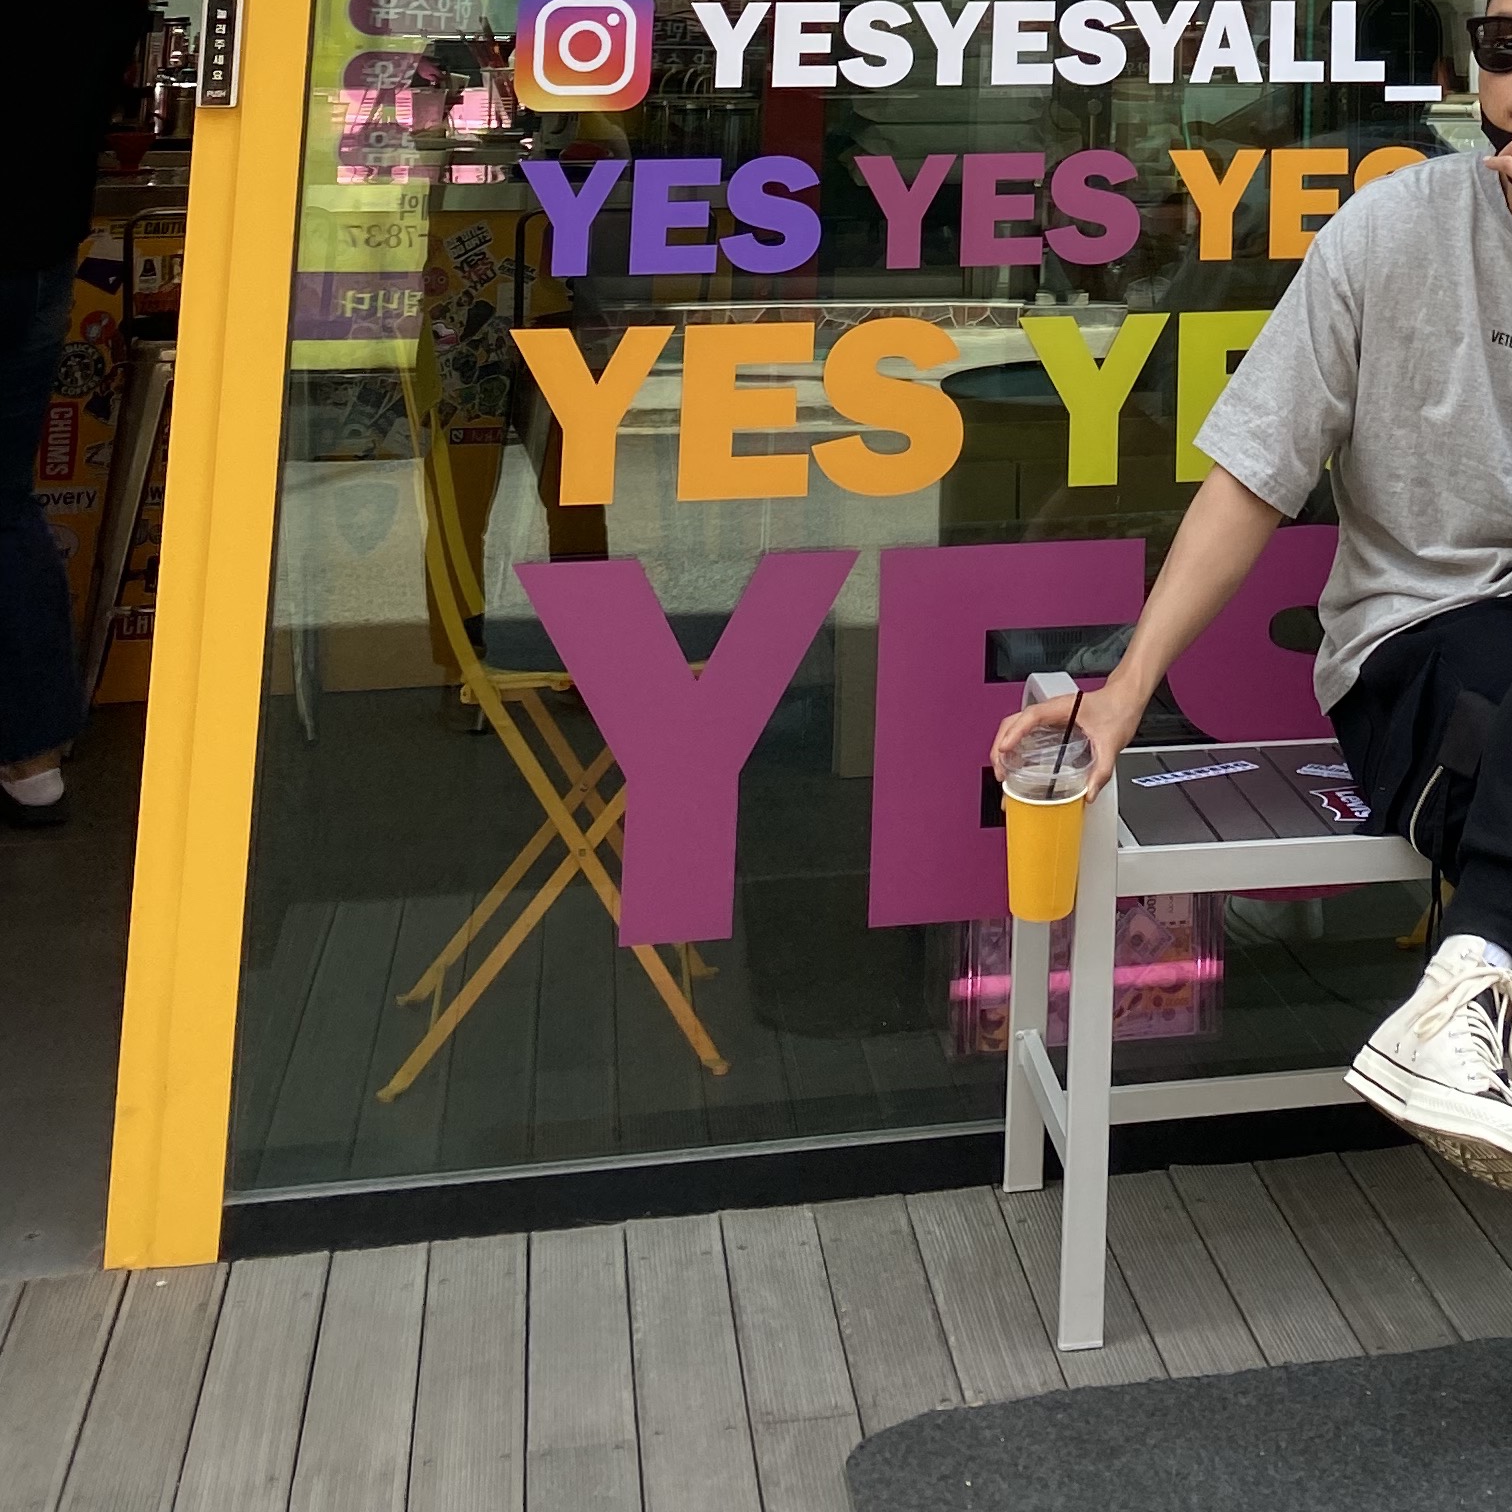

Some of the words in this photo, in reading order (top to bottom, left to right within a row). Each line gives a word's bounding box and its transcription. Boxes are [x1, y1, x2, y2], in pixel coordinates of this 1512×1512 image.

[206, 89, 227, 99] PUSH
[521, 155, 822, 277] YES
[854, 149, 1141, 270] YES
[1170, 146, 1425, 261] YE
[44, 406, 74, 477] CHUMS
[511, 317, 965, 507] YES
[1019, 310, 1272, 487] YE
